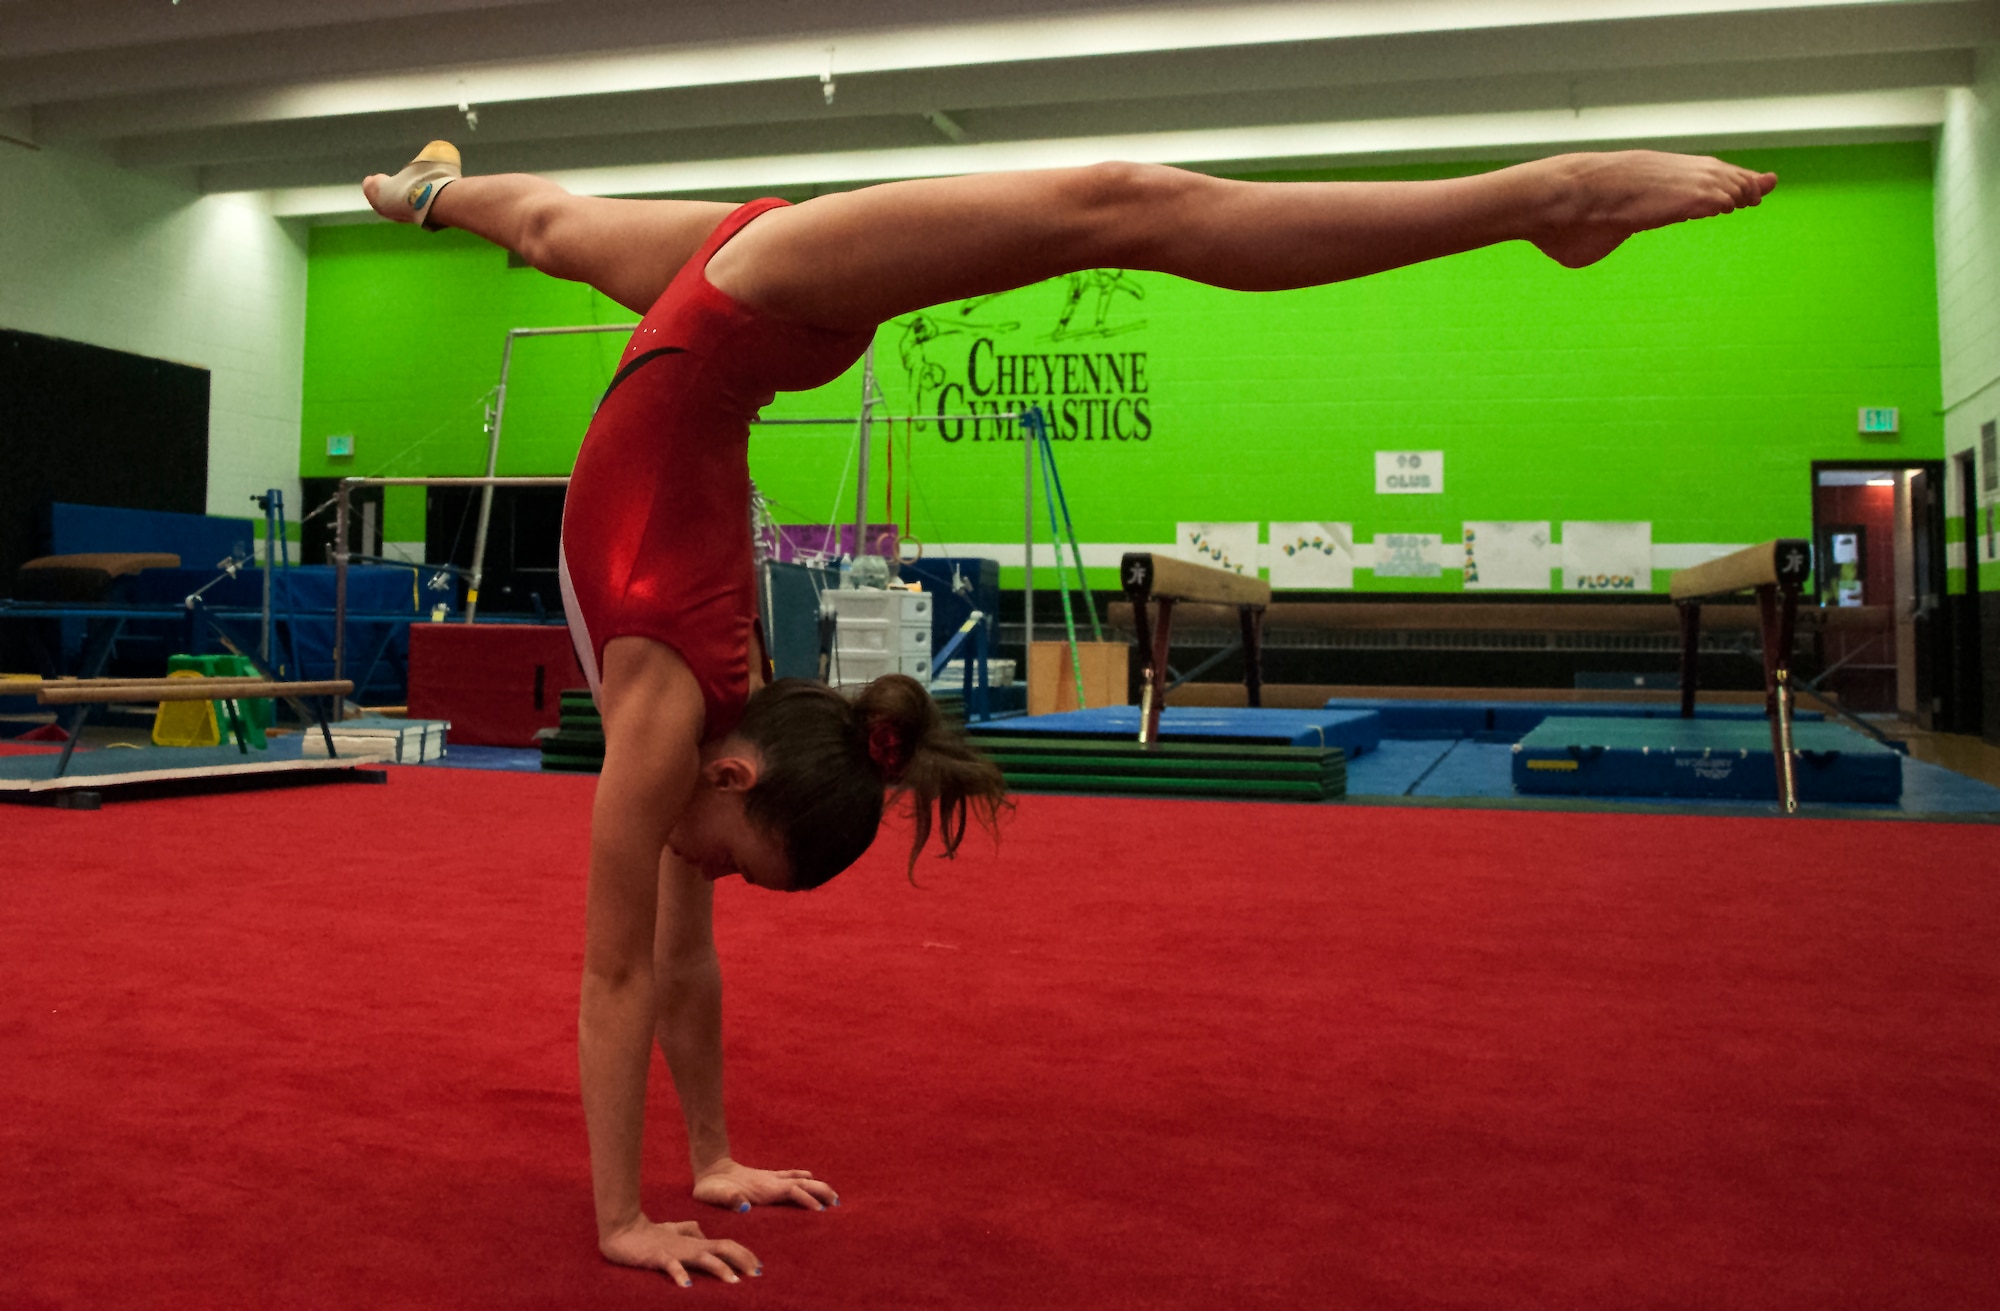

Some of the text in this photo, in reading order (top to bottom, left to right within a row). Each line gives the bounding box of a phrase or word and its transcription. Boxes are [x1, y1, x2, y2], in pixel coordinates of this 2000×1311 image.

[967, 337, 1149, 397] CHEYENNE
[937, 383, 1152, 442] GYMNASTICS
[1866, 409, 1893, 431] EXIT
[1189, 532, 1244, 575] VAULT
[1577, 574, 1635, 588] FLOOR
